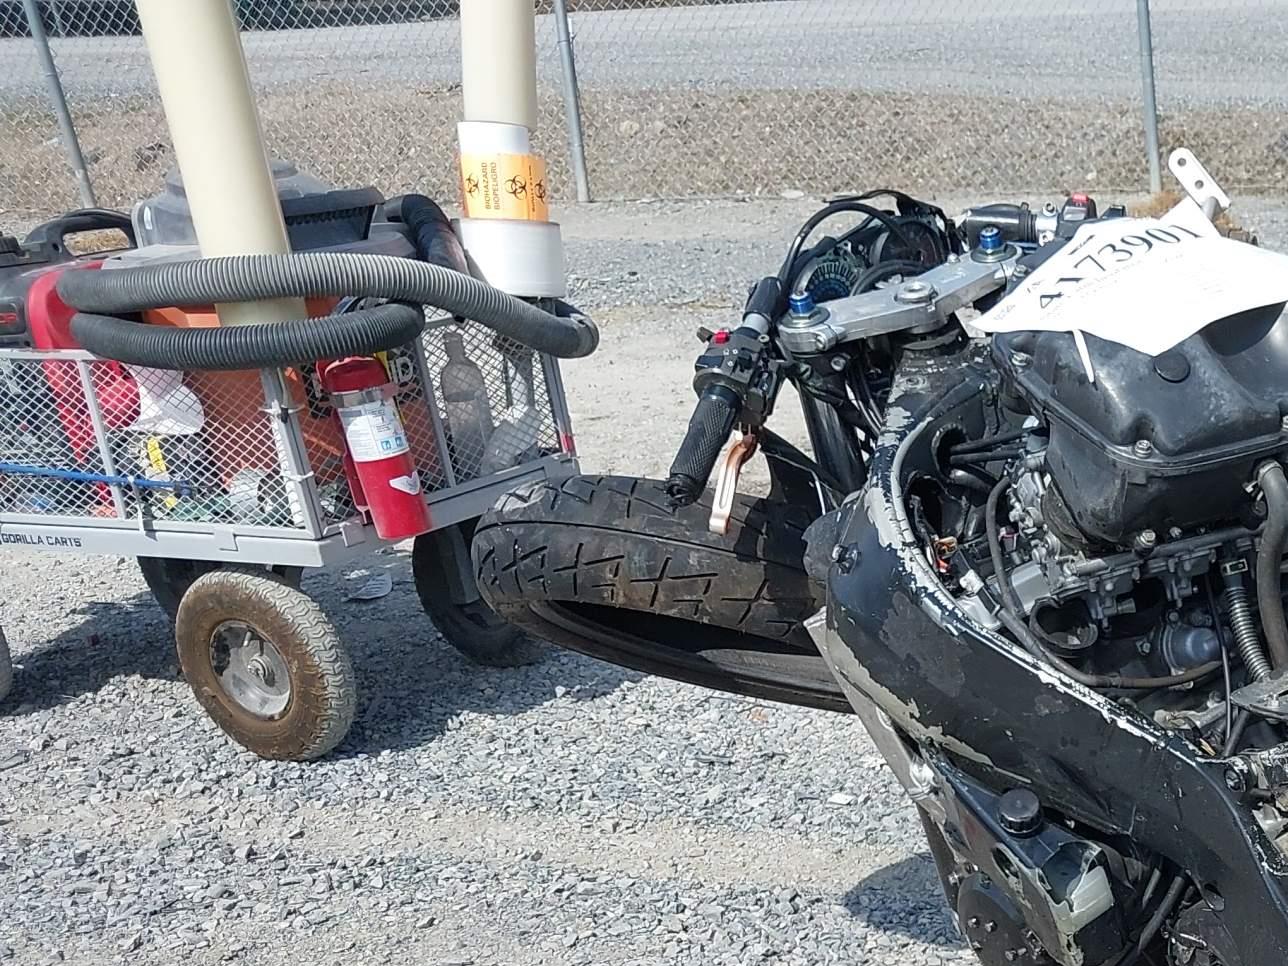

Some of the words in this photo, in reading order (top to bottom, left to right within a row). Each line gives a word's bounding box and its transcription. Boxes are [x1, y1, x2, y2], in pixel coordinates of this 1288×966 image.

[481, 162, 491, 209] BIOHAZARD
[490, 162, 501, 210] BIOPELIGRO
[1, 533, 45, 545] GORILLA
[46, 536, 82, 547] CARTS
